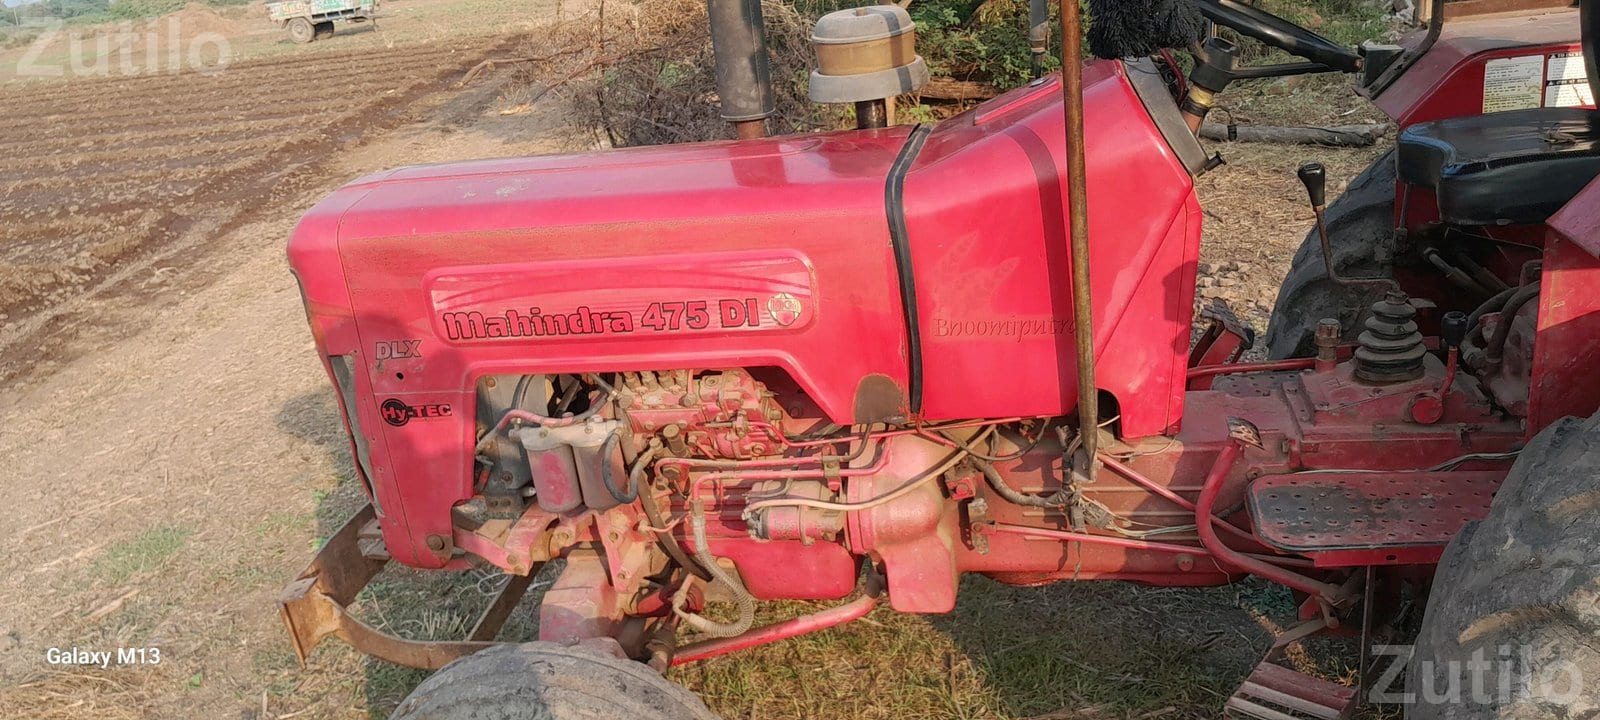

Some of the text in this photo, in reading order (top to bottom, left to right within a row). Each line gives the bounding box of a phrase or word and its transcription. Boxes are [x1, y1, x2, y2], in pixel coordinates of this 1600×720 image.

[443, 298, 759, 341] Mahindra 475 DI
[375, 340, 422, 360] DLX
[381, 402, 453, 423] Hy-TEC
